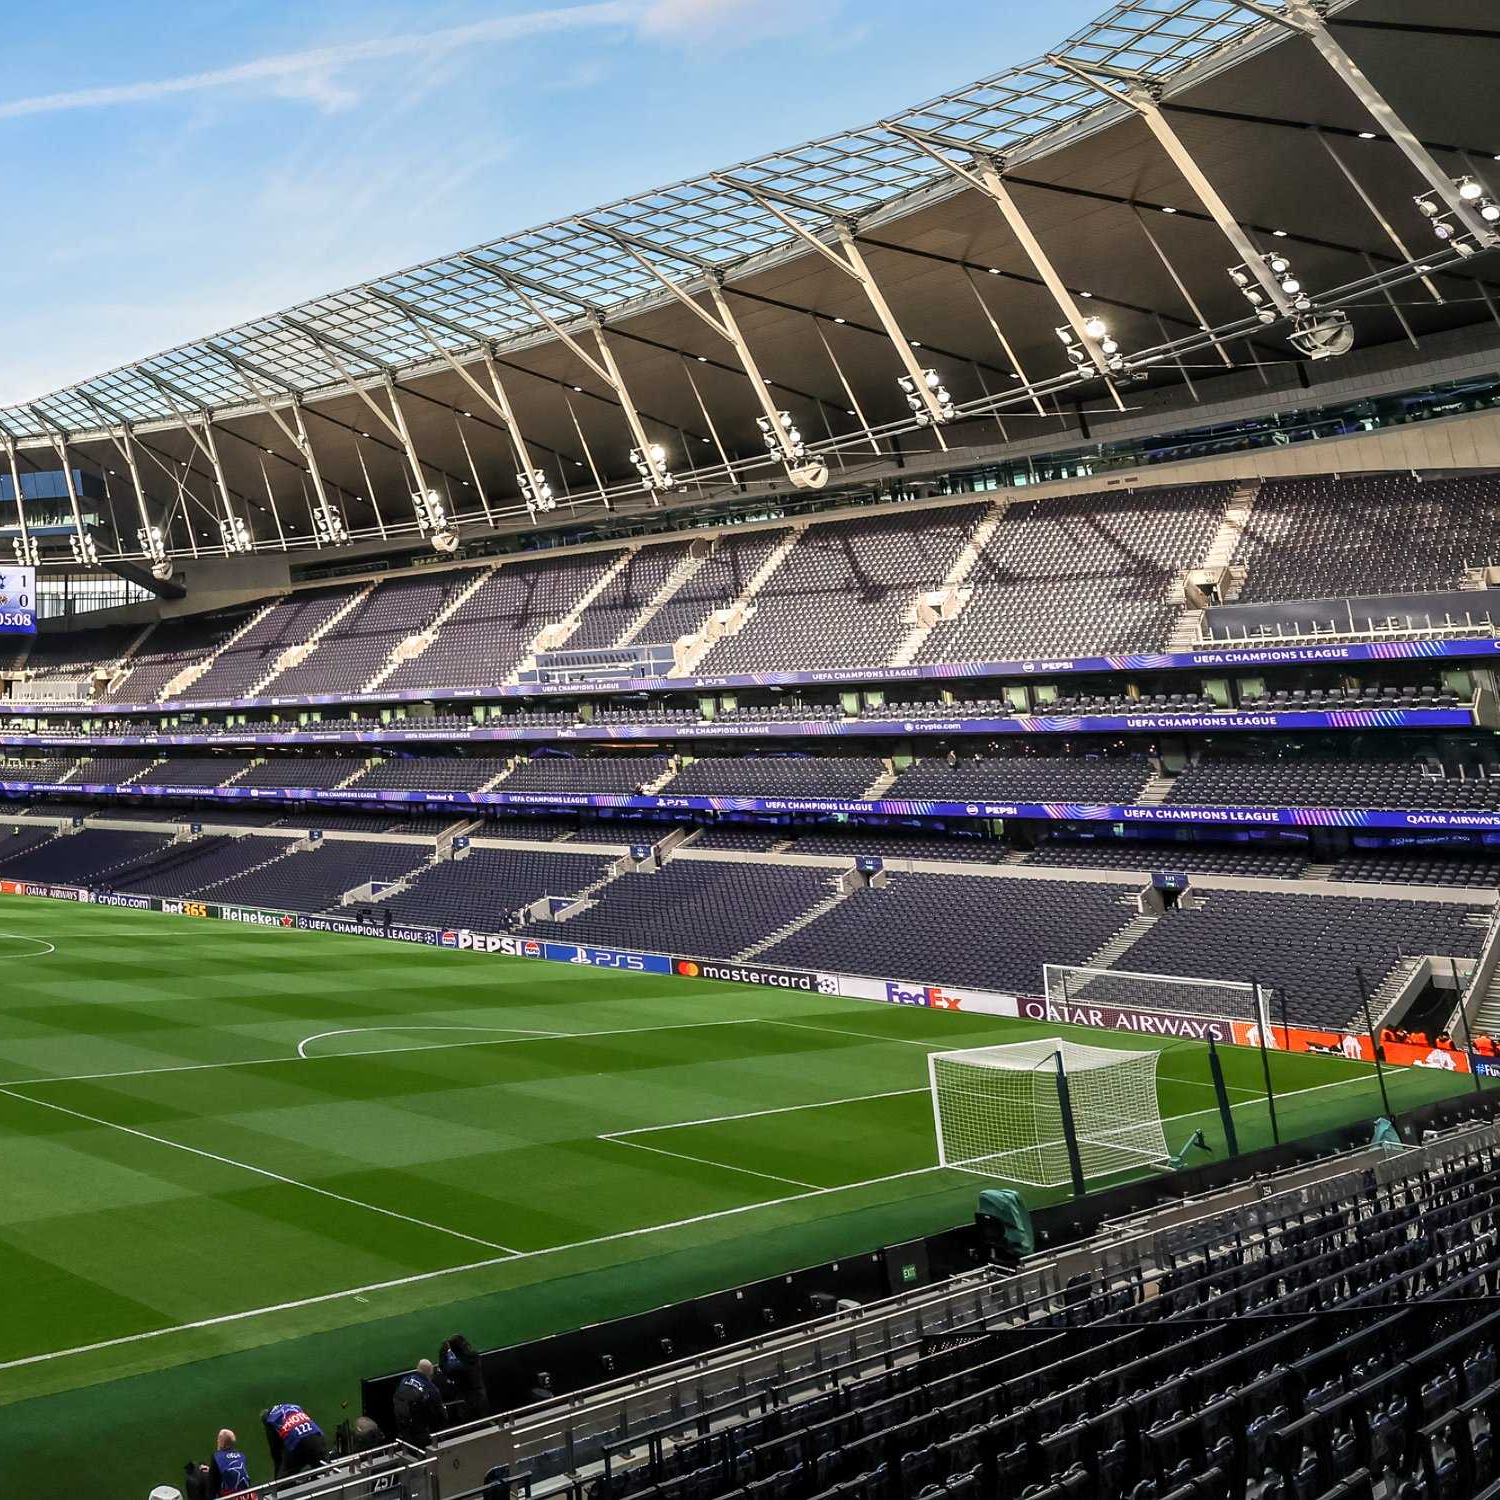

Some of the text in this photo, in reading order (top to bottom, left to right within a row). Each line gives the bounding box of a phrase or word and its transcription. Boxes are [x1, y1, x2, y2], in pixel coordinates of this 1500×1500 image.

[20, 575, 27, 588] 1
[20, 594, 28, 607] 0
[1194, 649, 1348, 663] UEFA CHAMPIONS LEAGUE
[1041, 662, 1073, 670] PEPSI
[832, 671, 883, 679] CHAMPIONS
[884, 669, 918, 677] LEAGUE
[915, 723, 961, 732] crypto.com
[1158, 718, 1227, 727] CHAMPIONS
[1230, 717, 1277, 725] LEAGUE
[787, 802, 838, 810] CHAMPIONS
[985, 806, 1017, 814] PEPSI
[1124, 810, 1279, 821] UEFA CHAMPIONS LEAGUE
[1406, 815, 1500, 825] QATAR AIRWAYS
[26, 886, 78, 900] QATAR AIRWAYS
[98, 894, 148, 909] crypto.com
[162, 900, 206, 917] bet365
[222, 907, 281, 926] Heineken
[309, 920, 424, 942] UEFA CHAMPIONS LEAGUE
[458, 931, 522, 956] PEPSI
[595, 952, 644, 970] PS5
[703, 964, 811, 990] mastercard
[886, 982, 962, 1011] FedEx
[1025, 1002, 1224, 1040] QATAR AIRWAYS
[294, 1422, 312, 1435] 122
